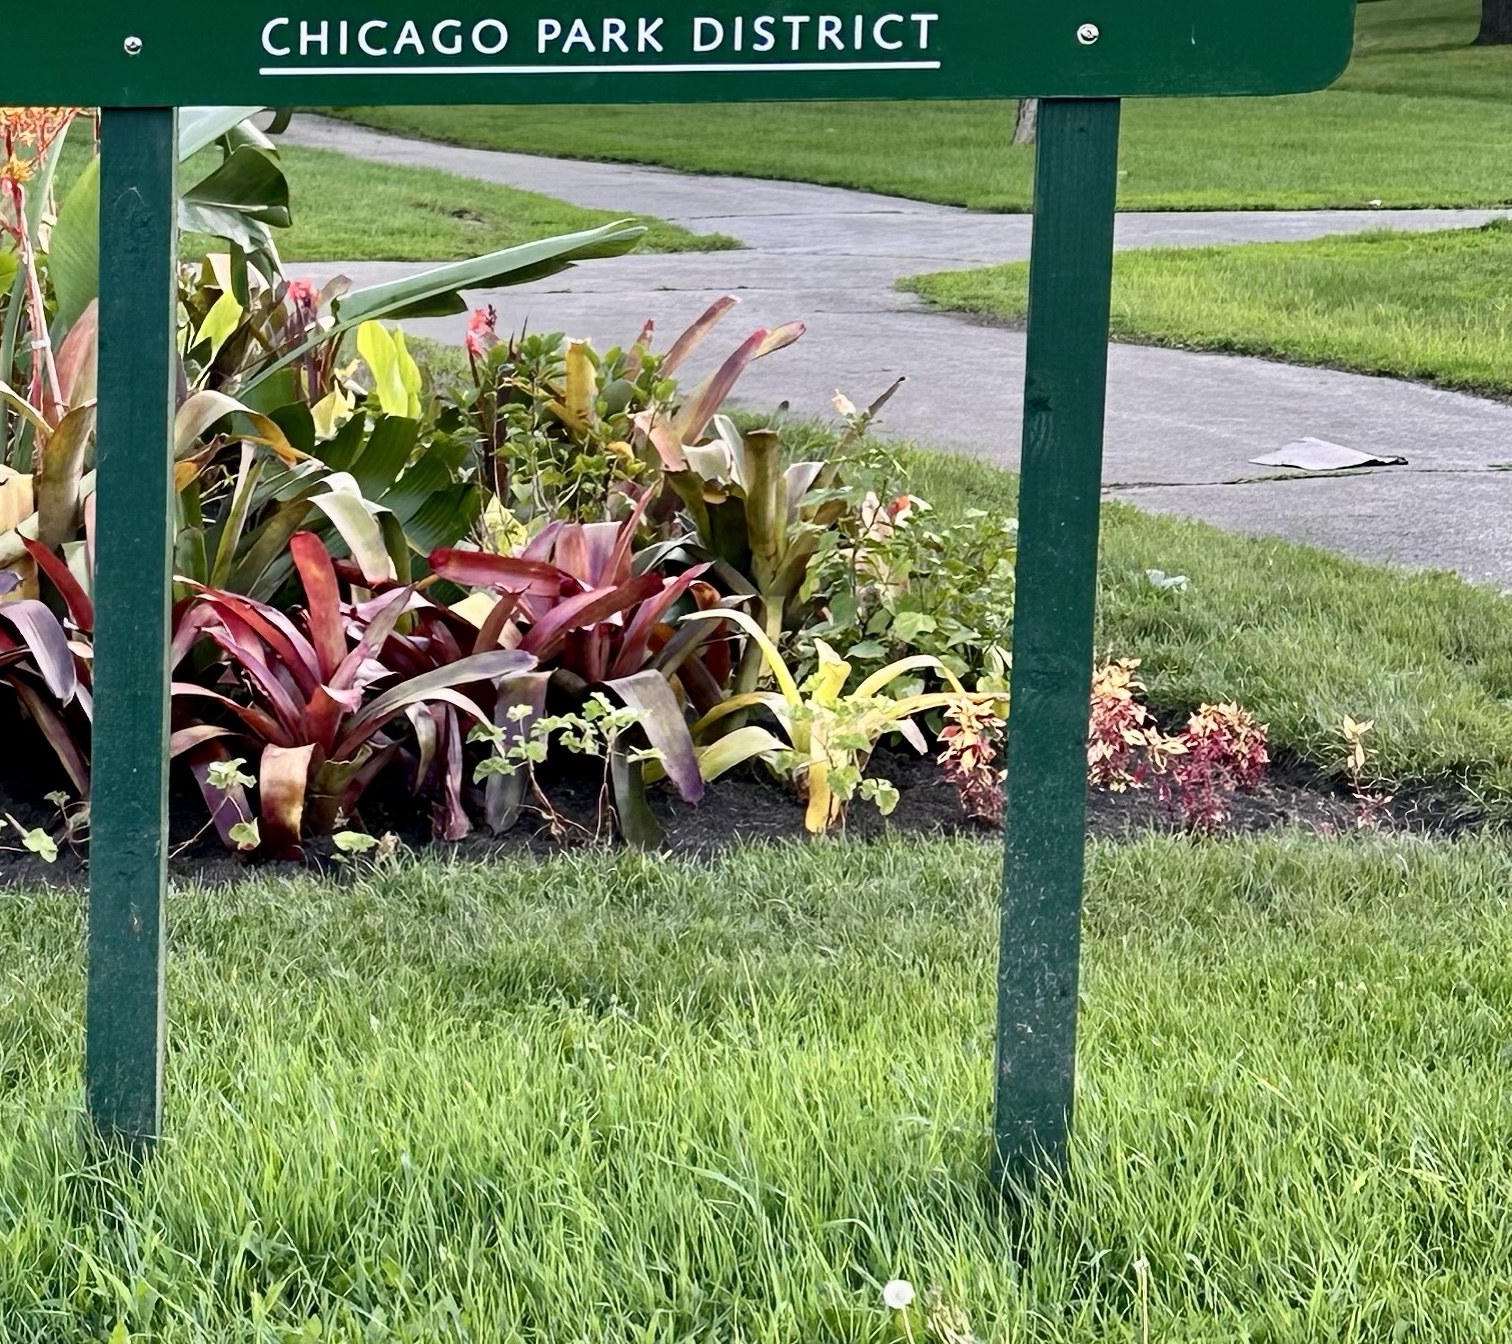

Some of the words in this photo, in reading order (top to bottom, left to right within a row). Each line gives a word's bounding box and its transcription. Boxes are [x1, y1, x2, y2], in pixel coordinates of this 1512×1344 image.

[261, 18, 508, 56] CHICAGO
[538, 17, 664, 53] PARK
[693, 13, 940, 52] DISTRICT
